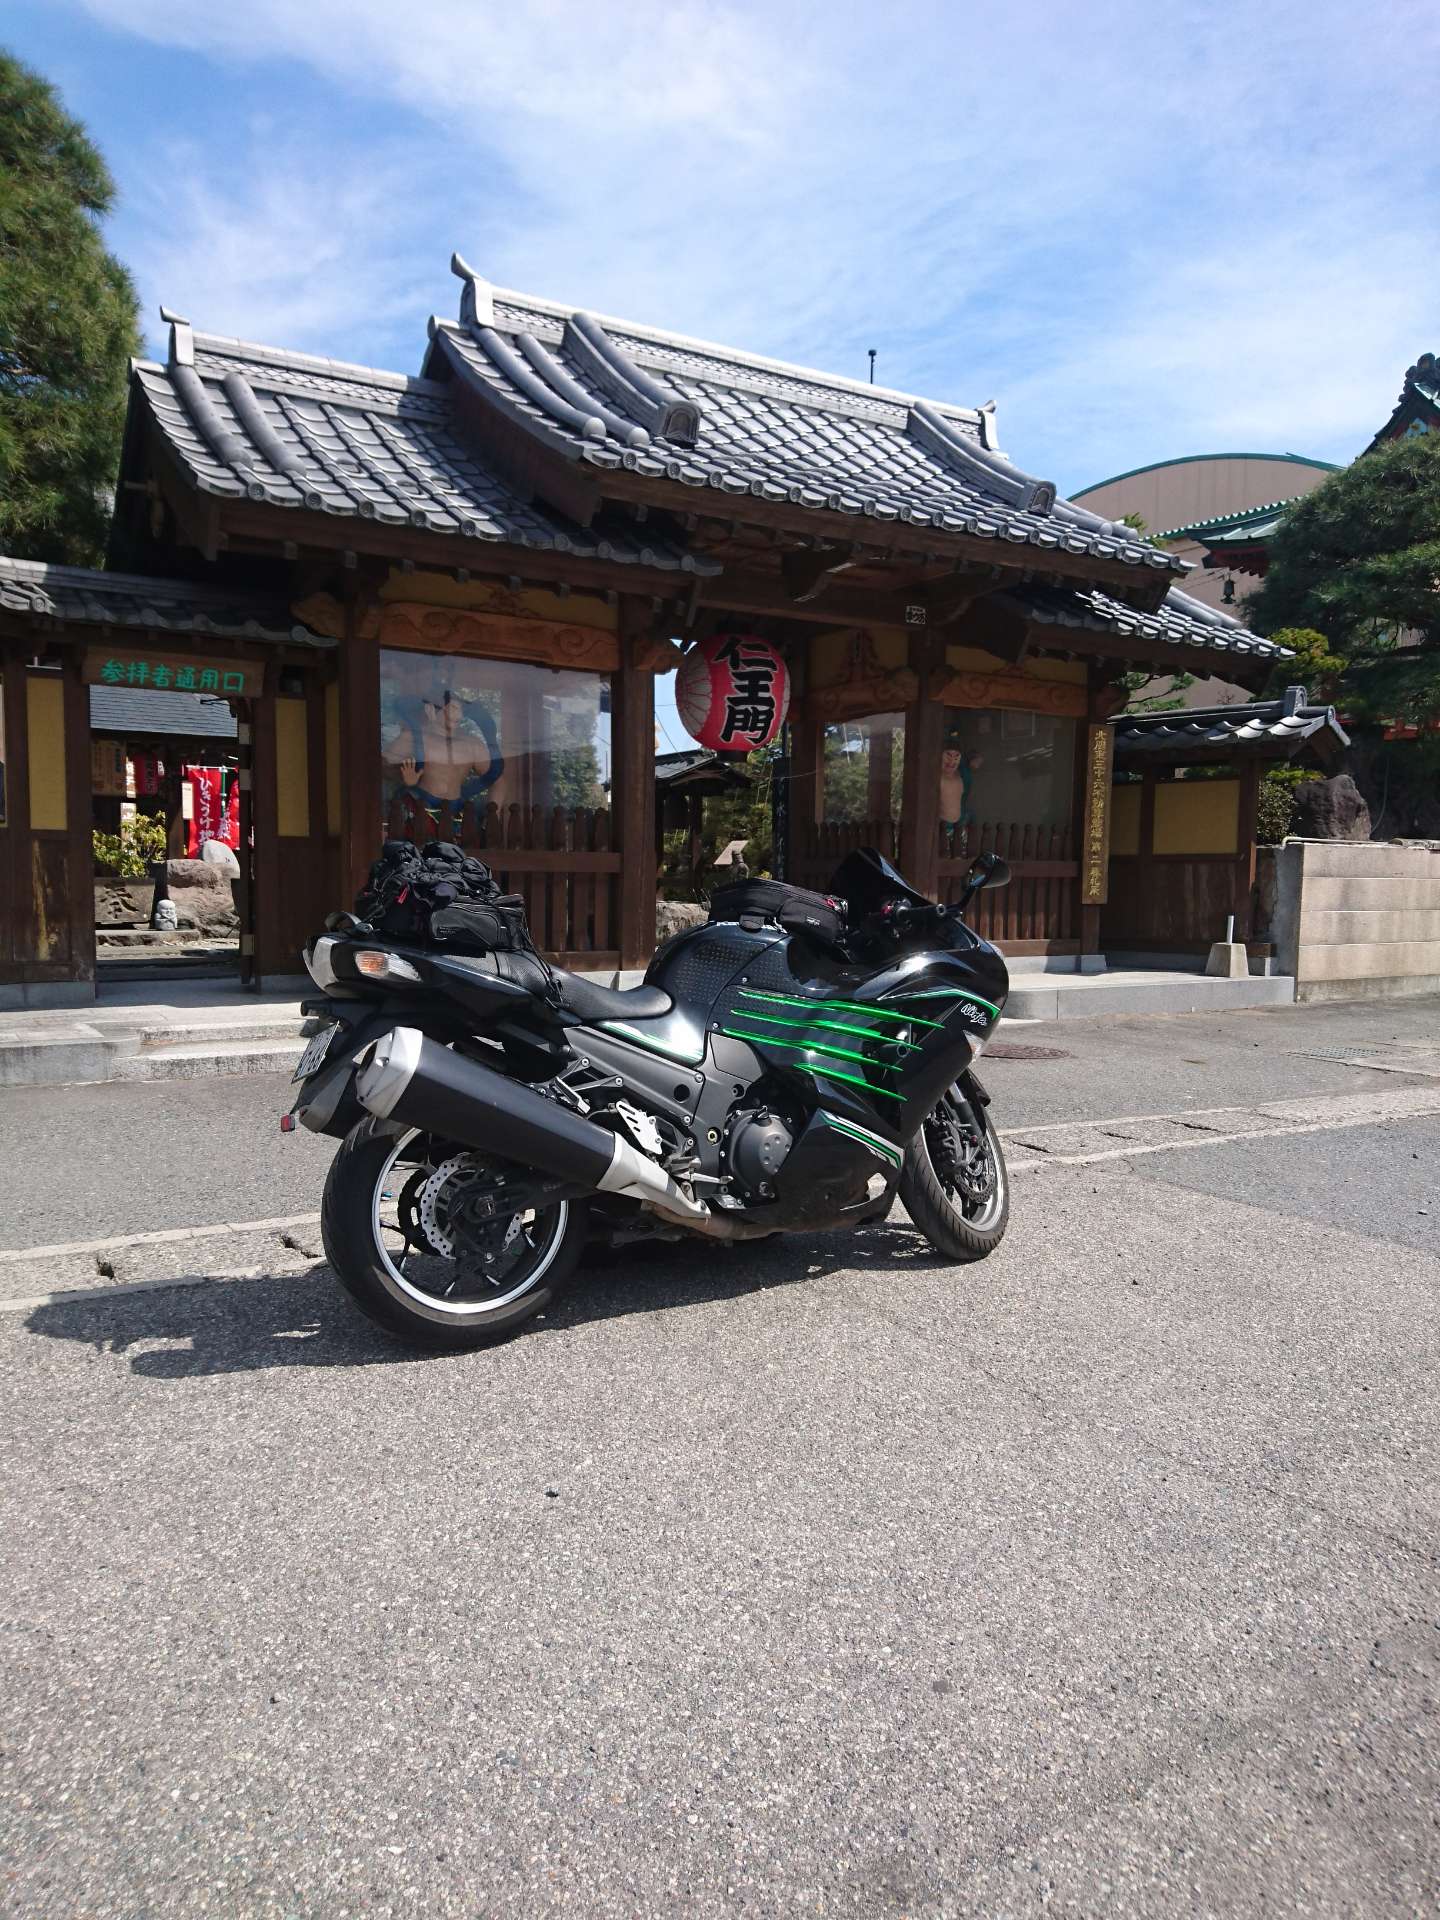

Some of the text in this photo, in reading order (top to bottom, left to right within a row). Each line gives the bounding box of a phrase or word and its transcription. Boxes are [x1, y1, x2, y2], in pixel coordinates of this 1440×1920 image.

[100, 658, 245, 693] 参拝者通用口
[711, 636, 778, 744] 仁王門
[961, 1003, 987, 1026] Ninja
